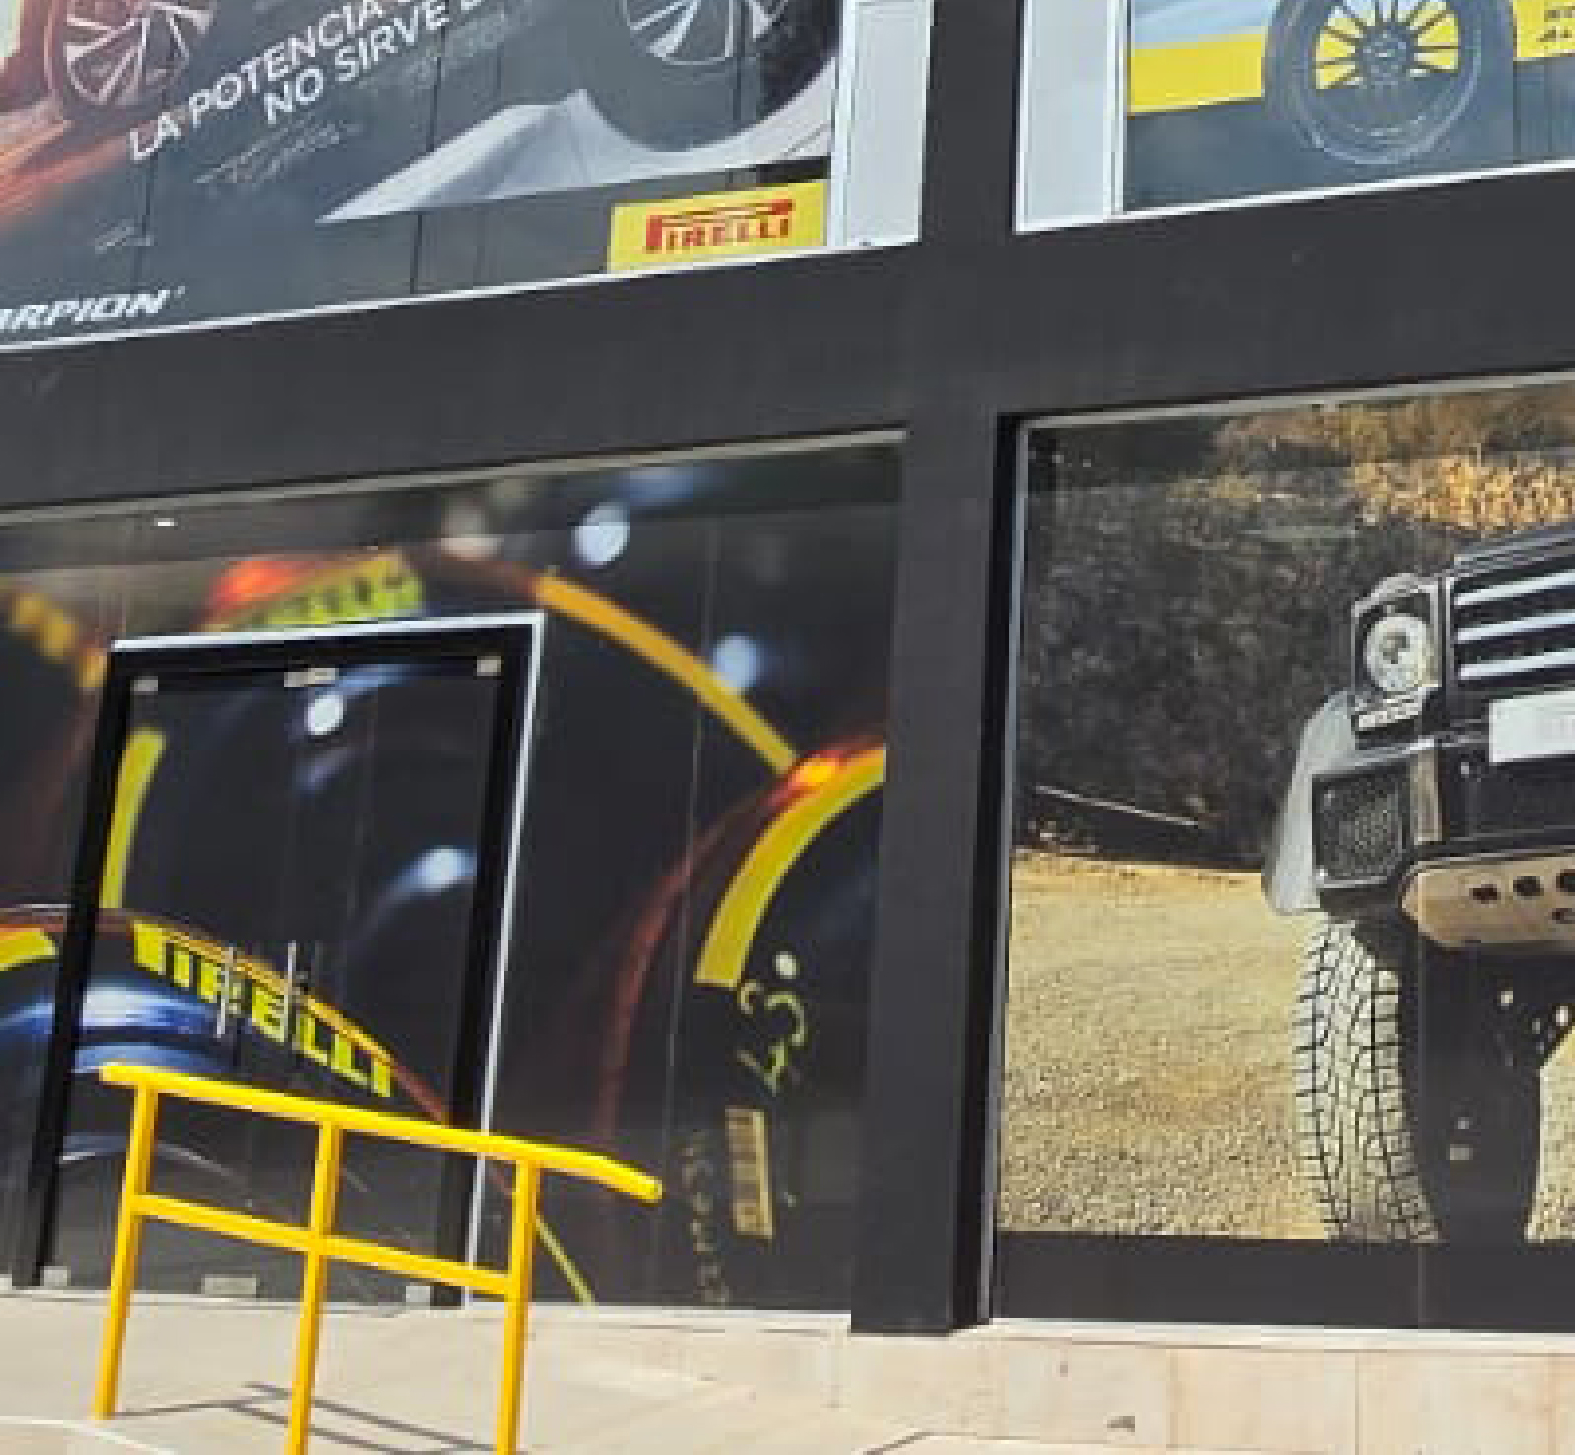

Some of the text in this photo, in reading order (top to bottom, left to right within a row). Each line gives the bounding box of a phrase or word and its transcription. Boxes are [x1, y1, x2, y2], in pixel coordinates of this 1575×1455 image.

[262, 66, 326, 126] NO
[128, 112, 183, 162] LA
[645, 197, 795, 253] PIRELLI
